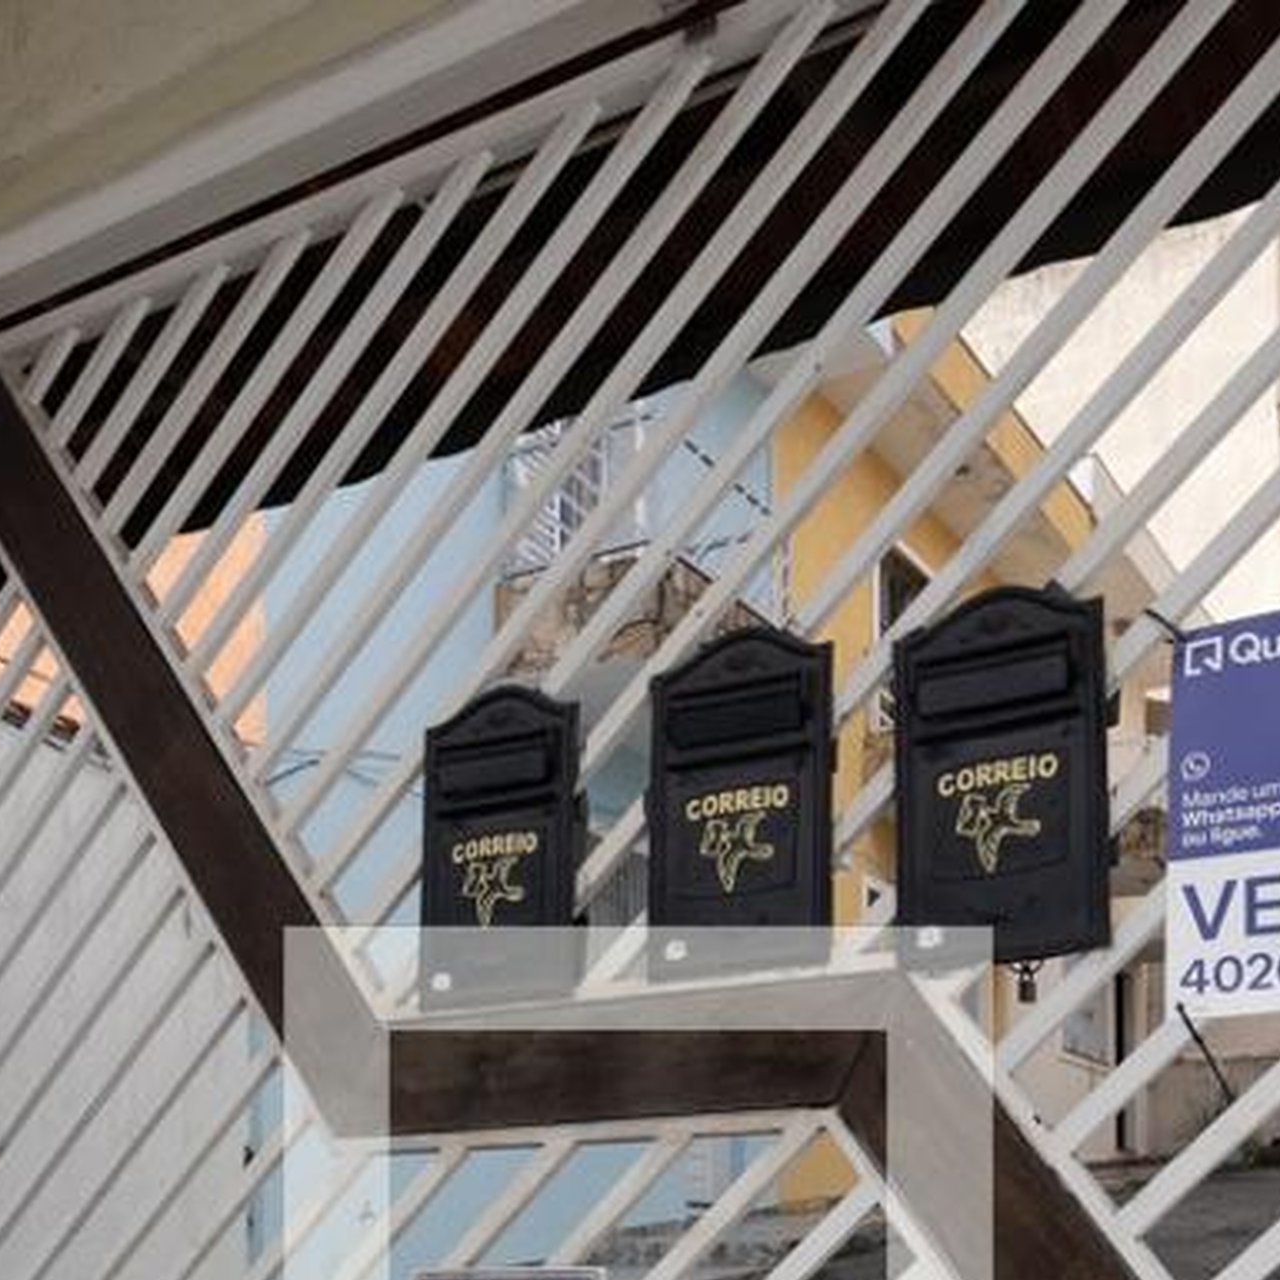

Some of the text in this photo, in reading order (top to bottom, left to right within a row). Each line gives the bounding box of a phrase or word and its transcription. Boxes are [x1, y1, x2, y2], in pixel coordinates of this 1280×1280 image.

[938, 752, 1058, 796] CORREIO
[686, 784, 789, 820] CORREIO
[1182, 784, 1249, 808] Mande
[452, 832, 538, 864] CORREIO
